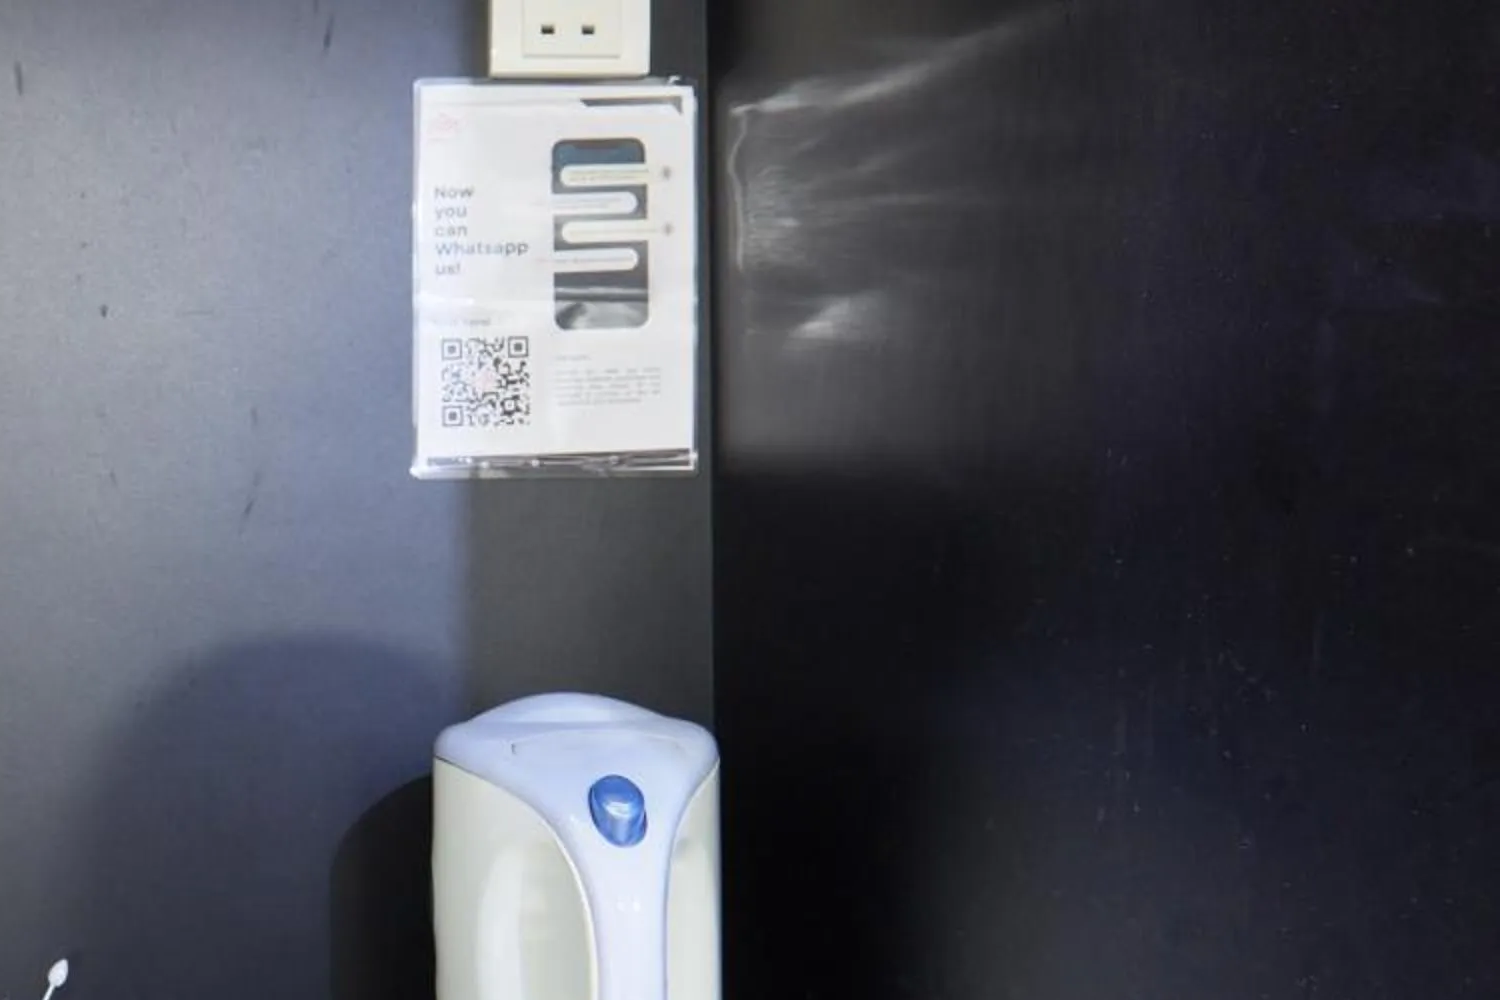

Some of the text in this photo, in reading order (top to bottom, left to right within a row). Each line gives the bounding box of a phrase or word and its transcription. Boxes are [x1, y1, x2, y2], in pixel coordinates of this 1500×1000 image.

[434, 185, 474, 200] Now
[434, 205, 467, 221] you
[434, 225, 467, 237] can
[434, 241, 529, 257] Whatsapp
